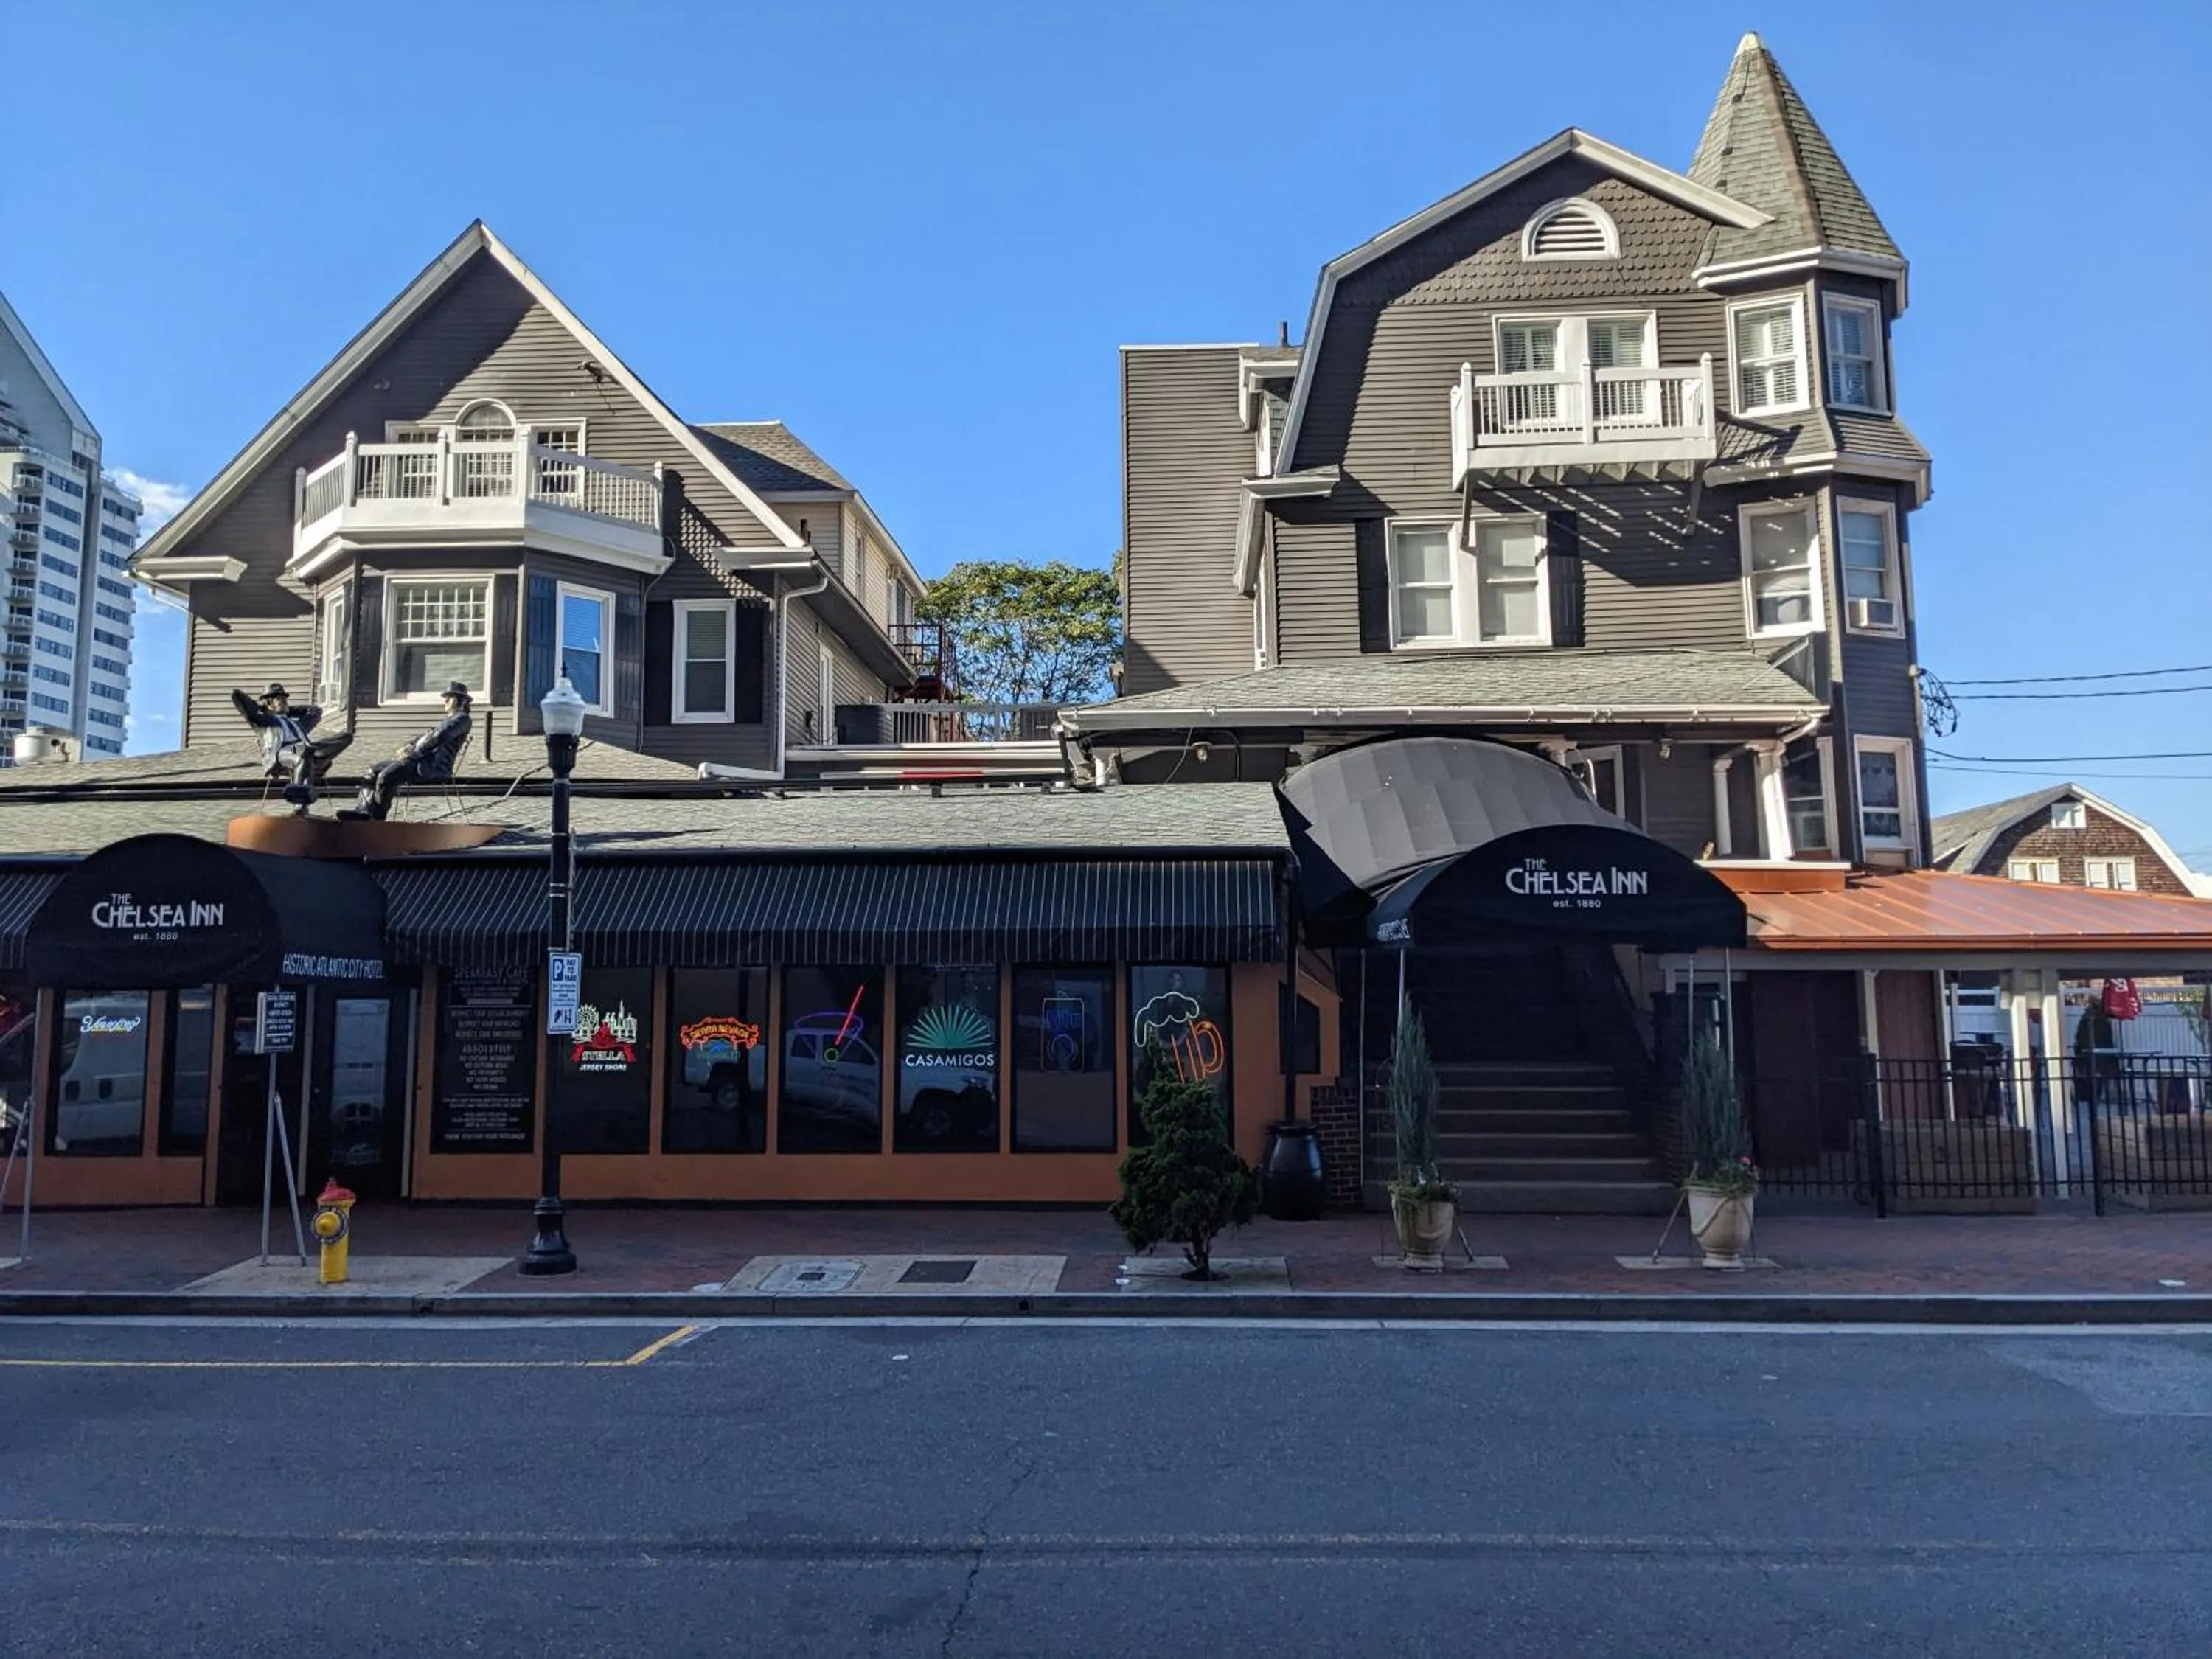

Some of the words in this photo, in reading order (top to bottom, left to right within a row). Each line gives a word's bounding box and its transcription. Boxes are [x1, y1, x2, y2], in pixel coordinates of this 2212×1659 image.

[1524, 858, 1547, 871] THE
[1505, 867, 1607, 894] CHELSEA
[1611, 866, 1648, 894] INN
[111, 893, 131, 905] THE
[1576, 899, 1601, 908] 1880
[92, 902, 186, 928] CHELSEA
[189, 899, 224, 927] INN
[905, 1053, 995, 1067] CASAMIGOS
